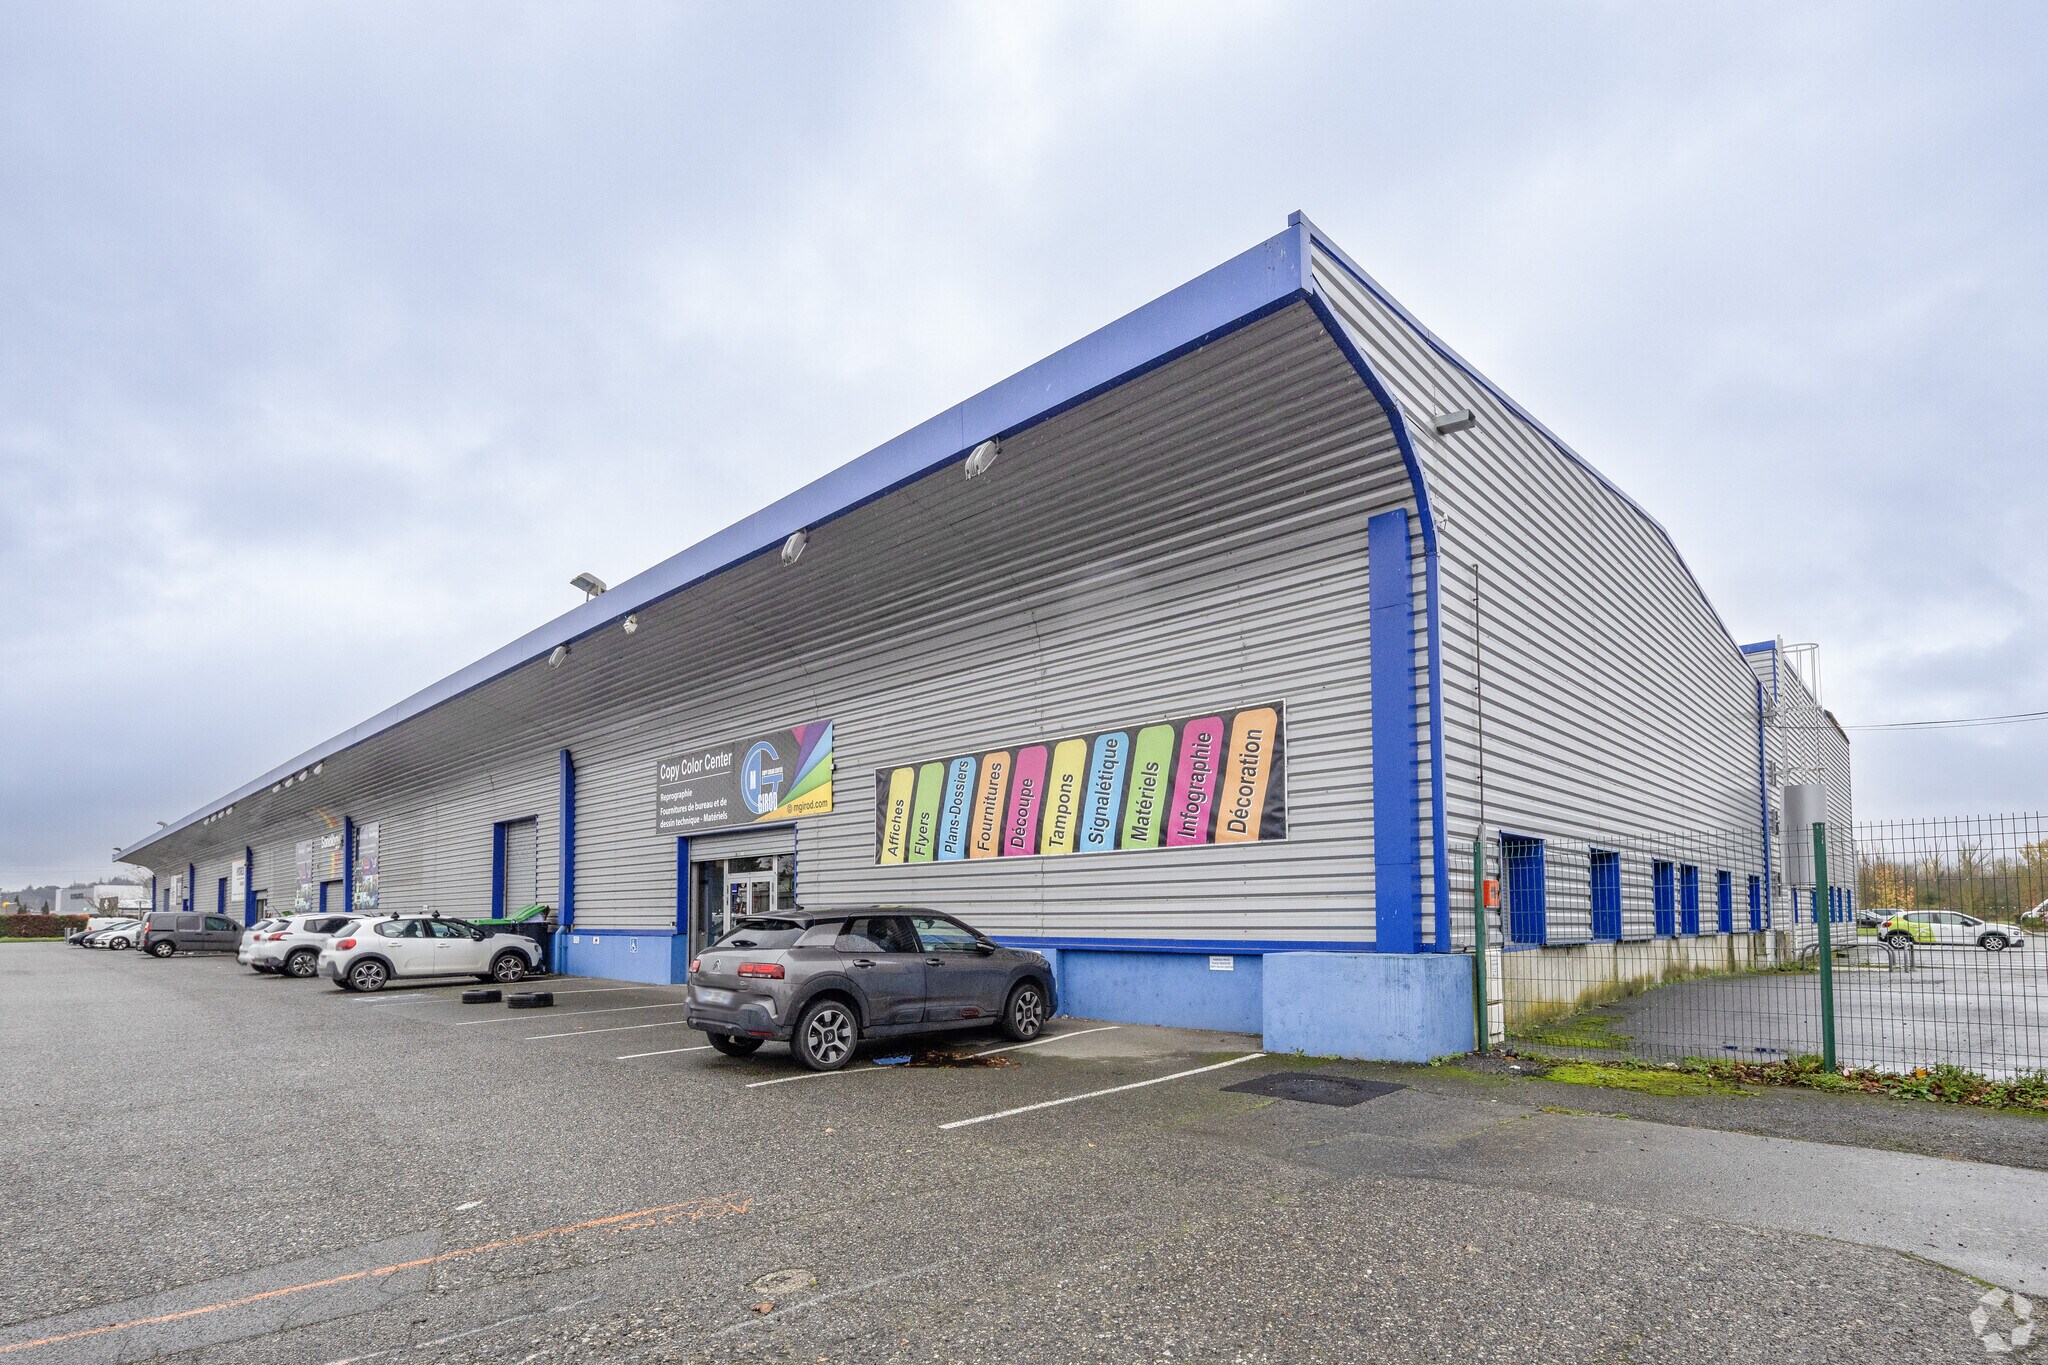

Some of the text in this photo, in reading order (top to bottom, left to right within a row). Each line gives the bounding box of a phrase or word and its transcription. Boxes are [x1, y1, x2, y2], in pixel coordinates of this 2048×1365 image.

[660, 751, 733, 781] Copy Color Center
[660, 788, 693, 802] Reprographie
[1088, 738, 1119, 845] Signalétique
[1177, 731, 1213, 838] Infographie
[1227, 729, 1263, 834] Décoration
[660, 797, 727, 816] Fournitures de bureau et de
[660, 818, 675, 828] dessin
[675, 815, 700, 826] technique
[703, 811, 728, 822] Matériels
[793, 800, 828, 813] mgirod.com
[887, 799, 904, 857] Affiches
[914, 811, 930, 856] Flyers
[945, 760, 969, 854] Plans-Dossiers
[977, 762, 1002, 851] Fournitures
[1011, 778, 1035, 848] Découpe
[1049, 773, 1074, 847] Tampons
[1131, 761, 1160, 842] Matériels
